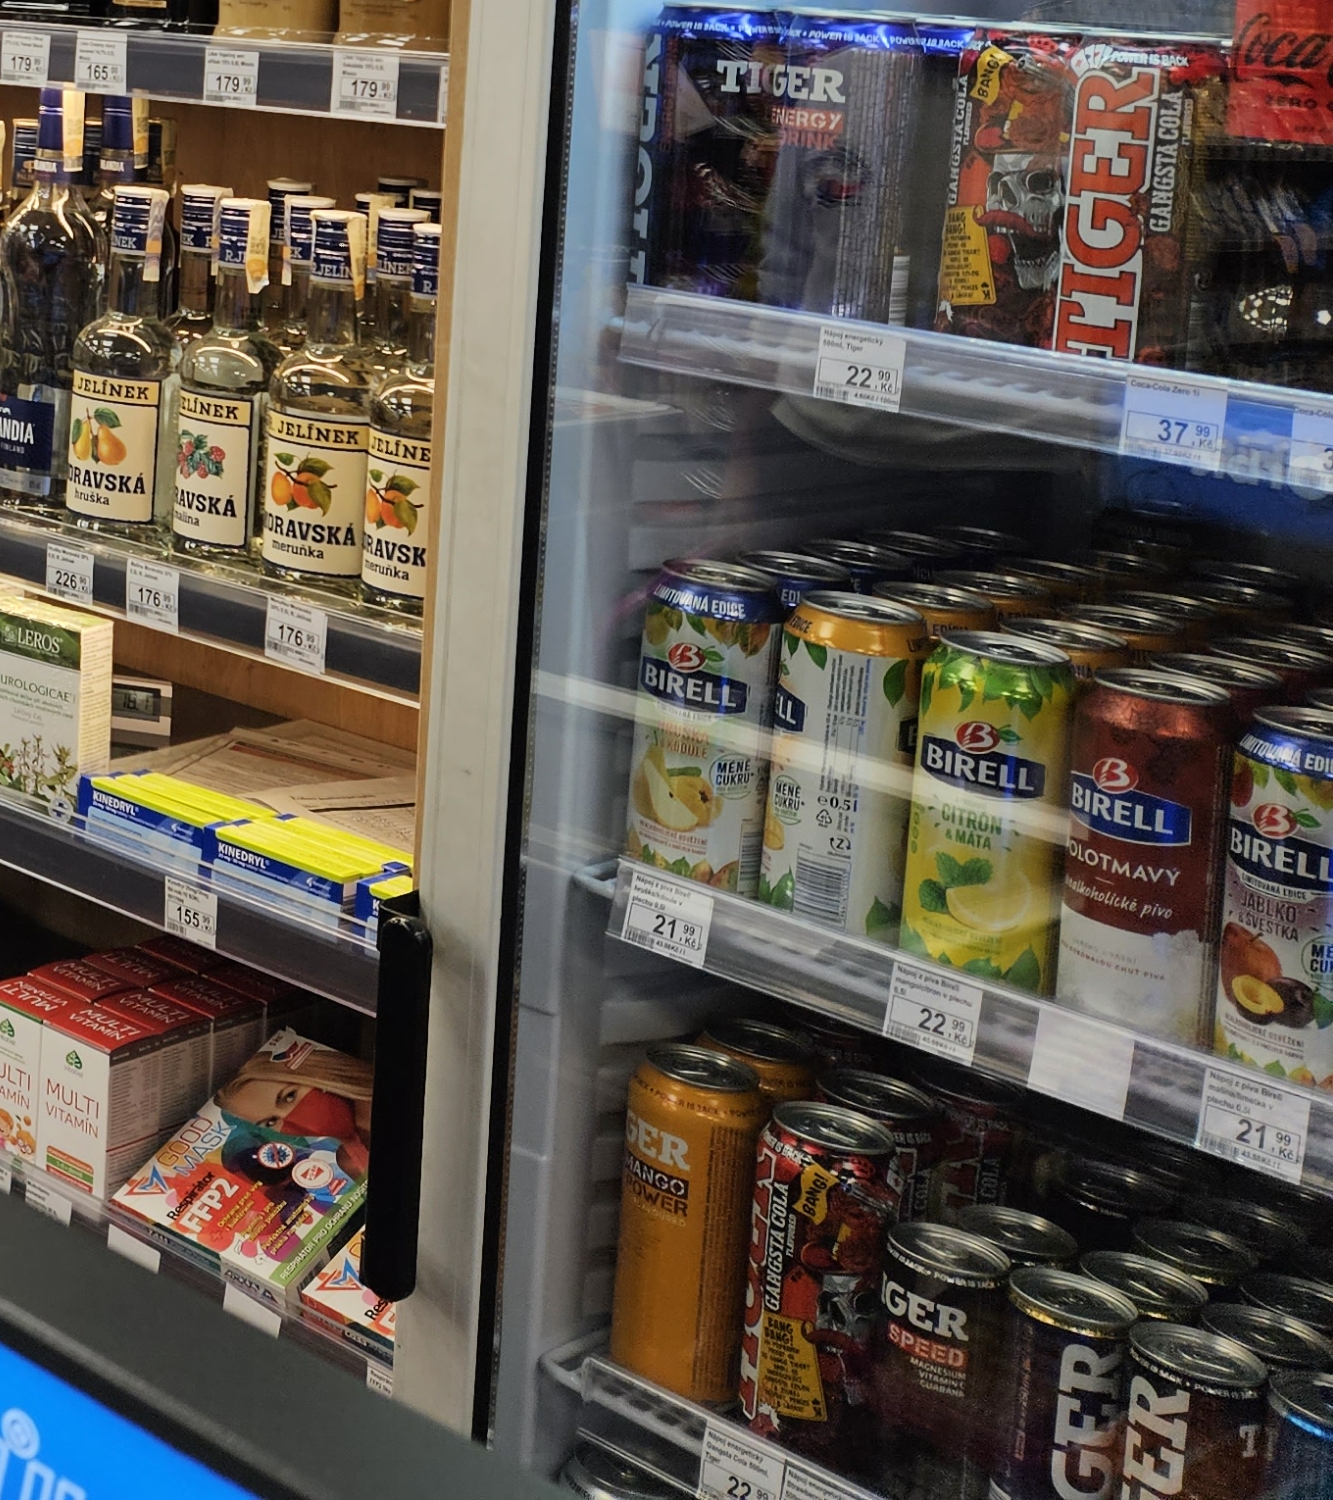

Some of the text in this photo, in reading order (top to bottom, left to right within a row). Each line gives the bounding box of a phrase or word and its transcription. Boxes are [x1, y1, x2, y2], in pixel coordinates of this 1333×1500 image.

[10, 55, 32, 71] 179
[86, 63, 110, 82] 165
[217, 75, 241, 93] 179
[351, 79, 378, 99] 179
[716, 57, 847, 105] TIGER
[1149, 88, 1184, 234] GANGSTA COLA
[1052, 66, 1161, 363] TIGER
[78, 377, 150, 402] JELÍNEK
[845, 365, 893, 393] 22 99 Kč
[277, 417, 360, 447] JELÍNEK
[1157, 419, 1189, 445] 37
[74, 489, 110, 507] hruška
[271, 538, 325, 561] meruňka
[54, 570, 78, 589] 226
[137, 587, 162, 607] 176
[653, 584, 746, 619] LIMITOVANÁ EDICE
[278, 624, 303, 646] 176
[644, 663, 737, 708] BIRELL
[924, 740, 1037, 794] BIRELL
[92, 788, 136, 817] KINEDRYL
[1071, 781, 1174, 836] BIRELL
[940, 806, 1003, 836] CITRÓN
[218, 841, 267, 871] KINEDRYL
[1230, 827, 1333, 883] BIRELL
[175, 903, 201, 929] 155
[652, 913, 678, 939] 21
[1139, 902, 1173, 921] pivo
[1245, 912, 1299, 943] ŠVESTKA
[918, 1008, 946, 1037] 22
[46, 1073, 102, 1120] MULTI
[45, 1101, 99, 1139] VITAMÍN
[1235, 1118, 1266, 1150] 21
[156, 1117, 213, 1168] GOOD
[173, 1122, 232, 1176] MASK
[166, 1169, 216, 1221] Respirátor
[180, 1177, 240, 1234] FFP2
[887, 1323, 965, 1369] SPEED
